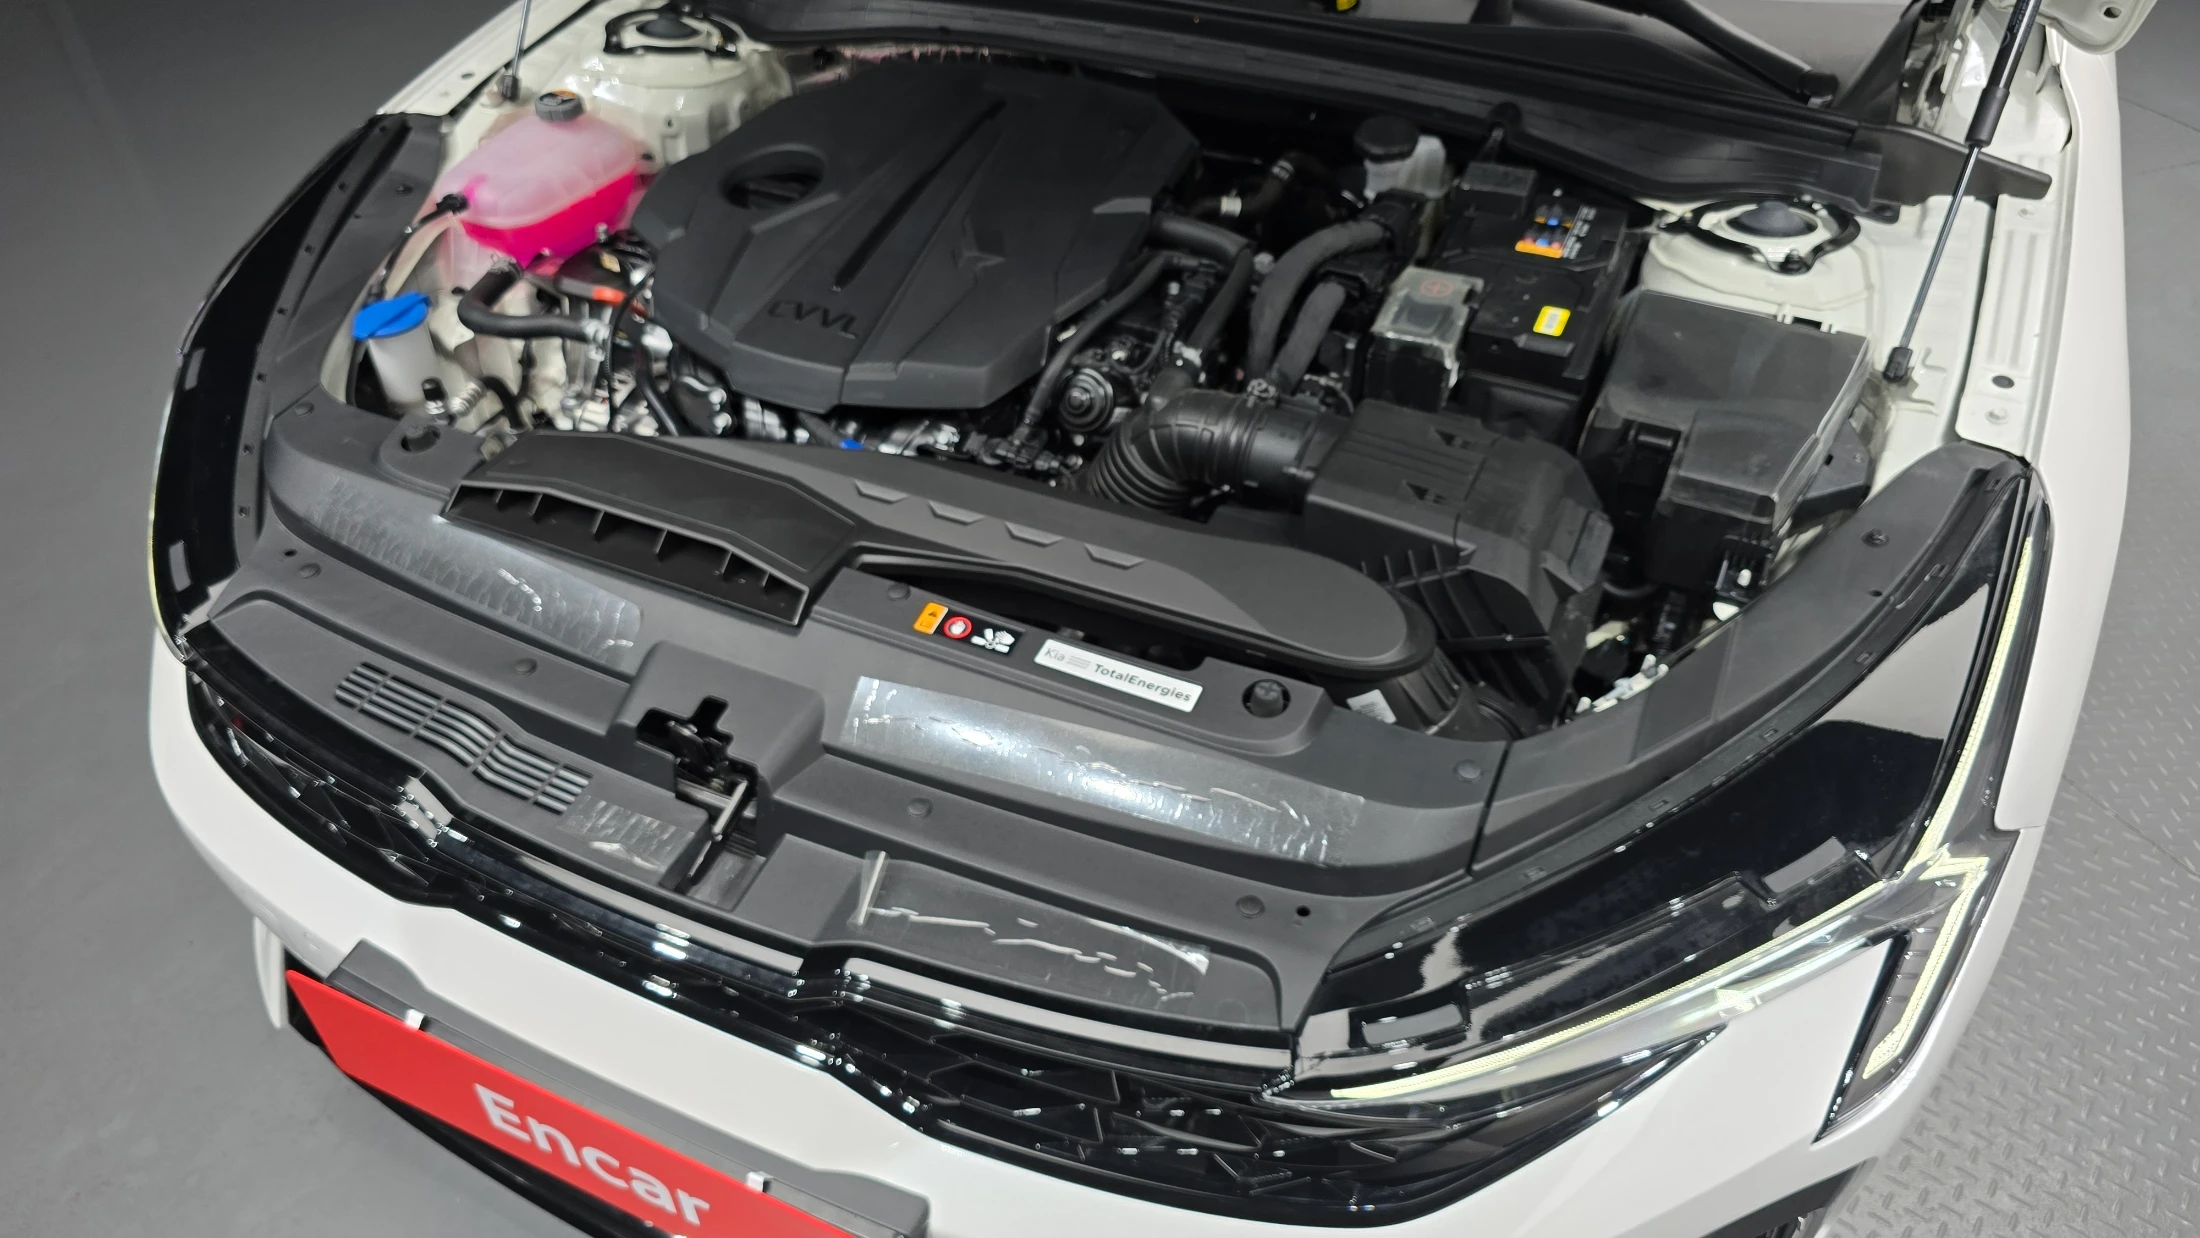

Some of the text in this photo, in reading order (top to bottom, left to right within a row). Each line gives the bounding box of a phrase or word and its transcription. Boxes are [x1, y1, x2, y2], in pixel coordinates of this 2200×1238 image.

[1044, 648, 1192, 702] Kia TotalEnergies
[473, 1083, 710, 1225] Encar
